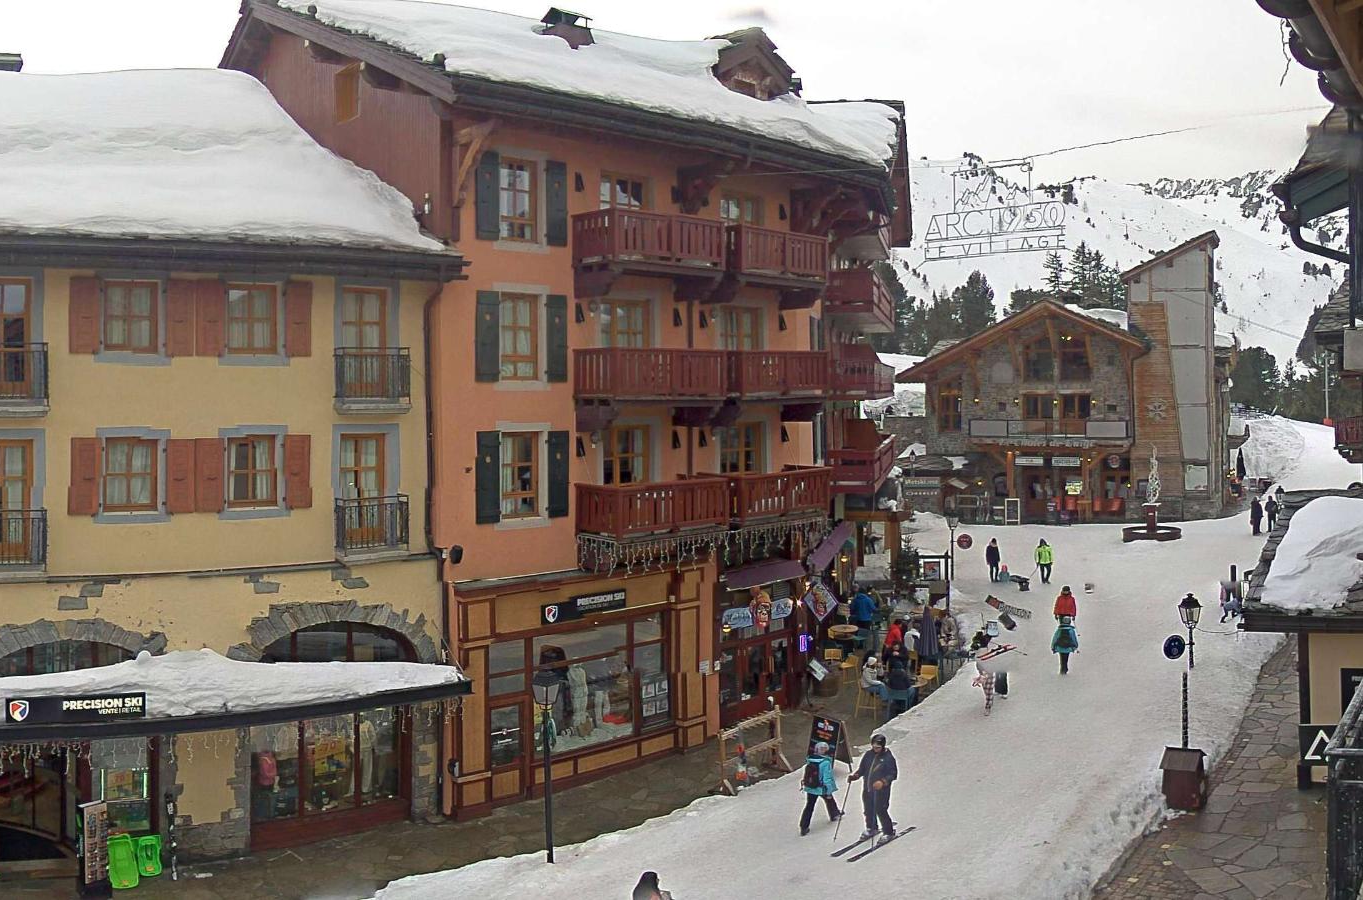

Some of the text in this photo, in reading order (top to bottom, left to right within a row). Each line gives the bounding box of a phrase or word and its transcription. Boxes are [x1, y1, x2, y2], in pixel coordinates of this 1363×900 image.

[925, 201, 1066, 241] ARC 1950
[63, 696, 143, 711] PRECISION SKI
[98, 707, 119, 715] VENTE
